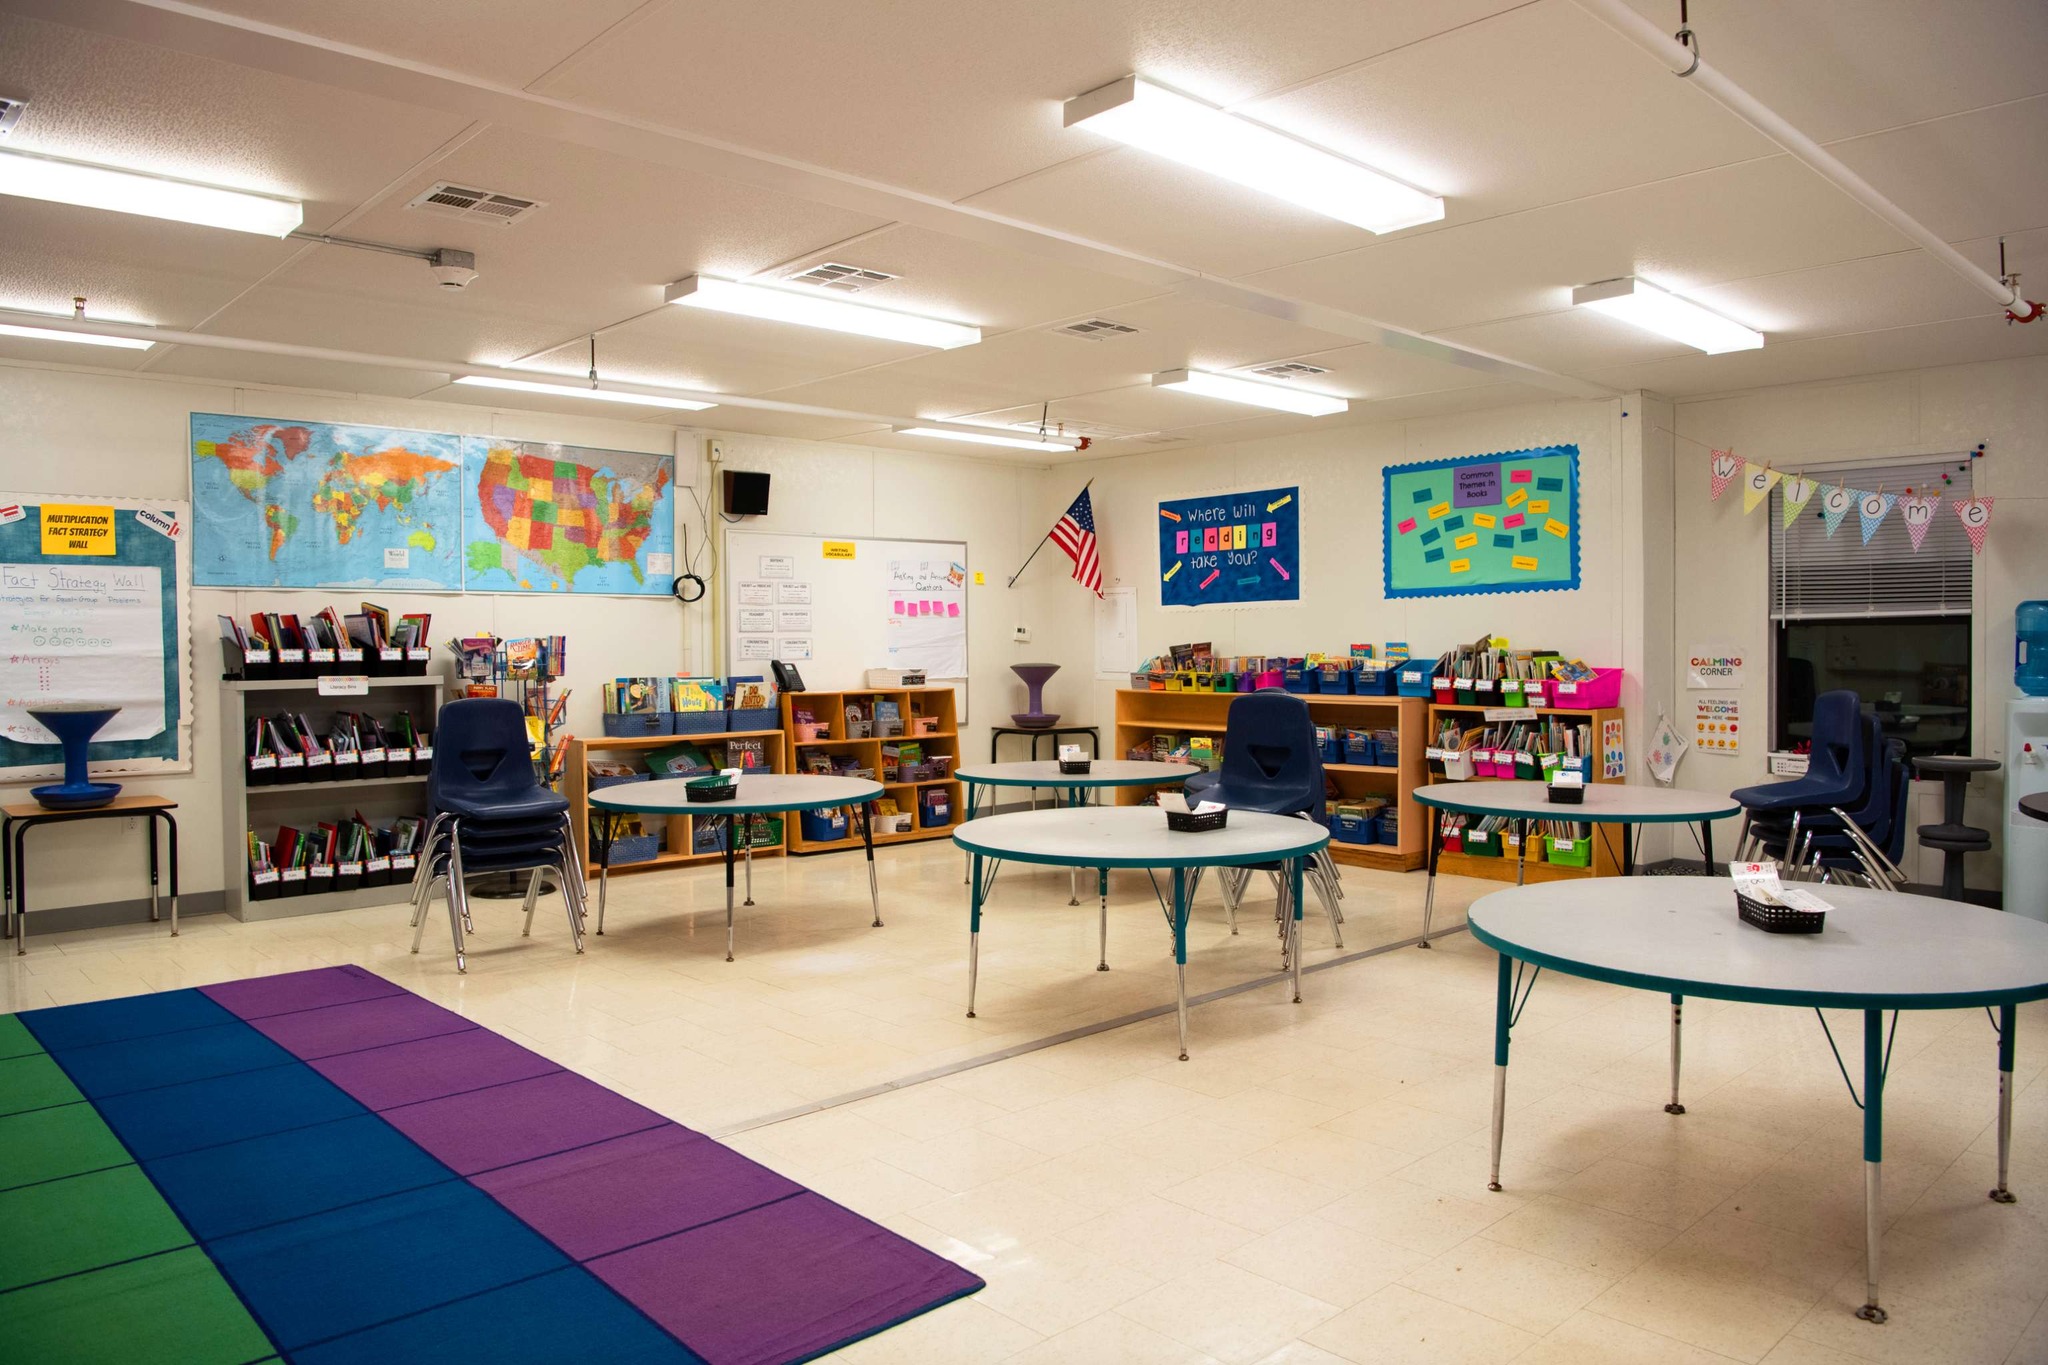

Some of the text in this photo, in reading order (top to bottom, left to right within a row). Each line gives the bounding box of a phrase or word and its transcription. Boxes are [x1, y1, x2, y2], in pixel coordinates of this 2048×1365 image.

[1460, 471, 1494, 480] Common
[1459, 481, 1486, 490] Themes
[1466, 490, 1488, 498] Books
[1187, 507, 1226, 522] Where
[47, 514, 108, 525] MULTIPLICATION
[140, 510, 170, 531] column
[48, 527, 108, 537] FACT STRATEGY
[1180, 527, 1273, 547] reading
[68, 540, 88, 549] WALL
[1191, 550, 1258, 570] take you?
[3, 566, 145, 594] Fact Strategy Wall
[915, 582, 943, 591] Questions
[21, 624, 83, 638] Make groups
[22, 655, 60, 667] Arrays
[1691, 658, 1742, 666] CALMING
[1700, 667, 1733, 676] CORNER
[1697, 705, 1738, 713] WELCOME
[730, 741, 761, 750] Perfect
